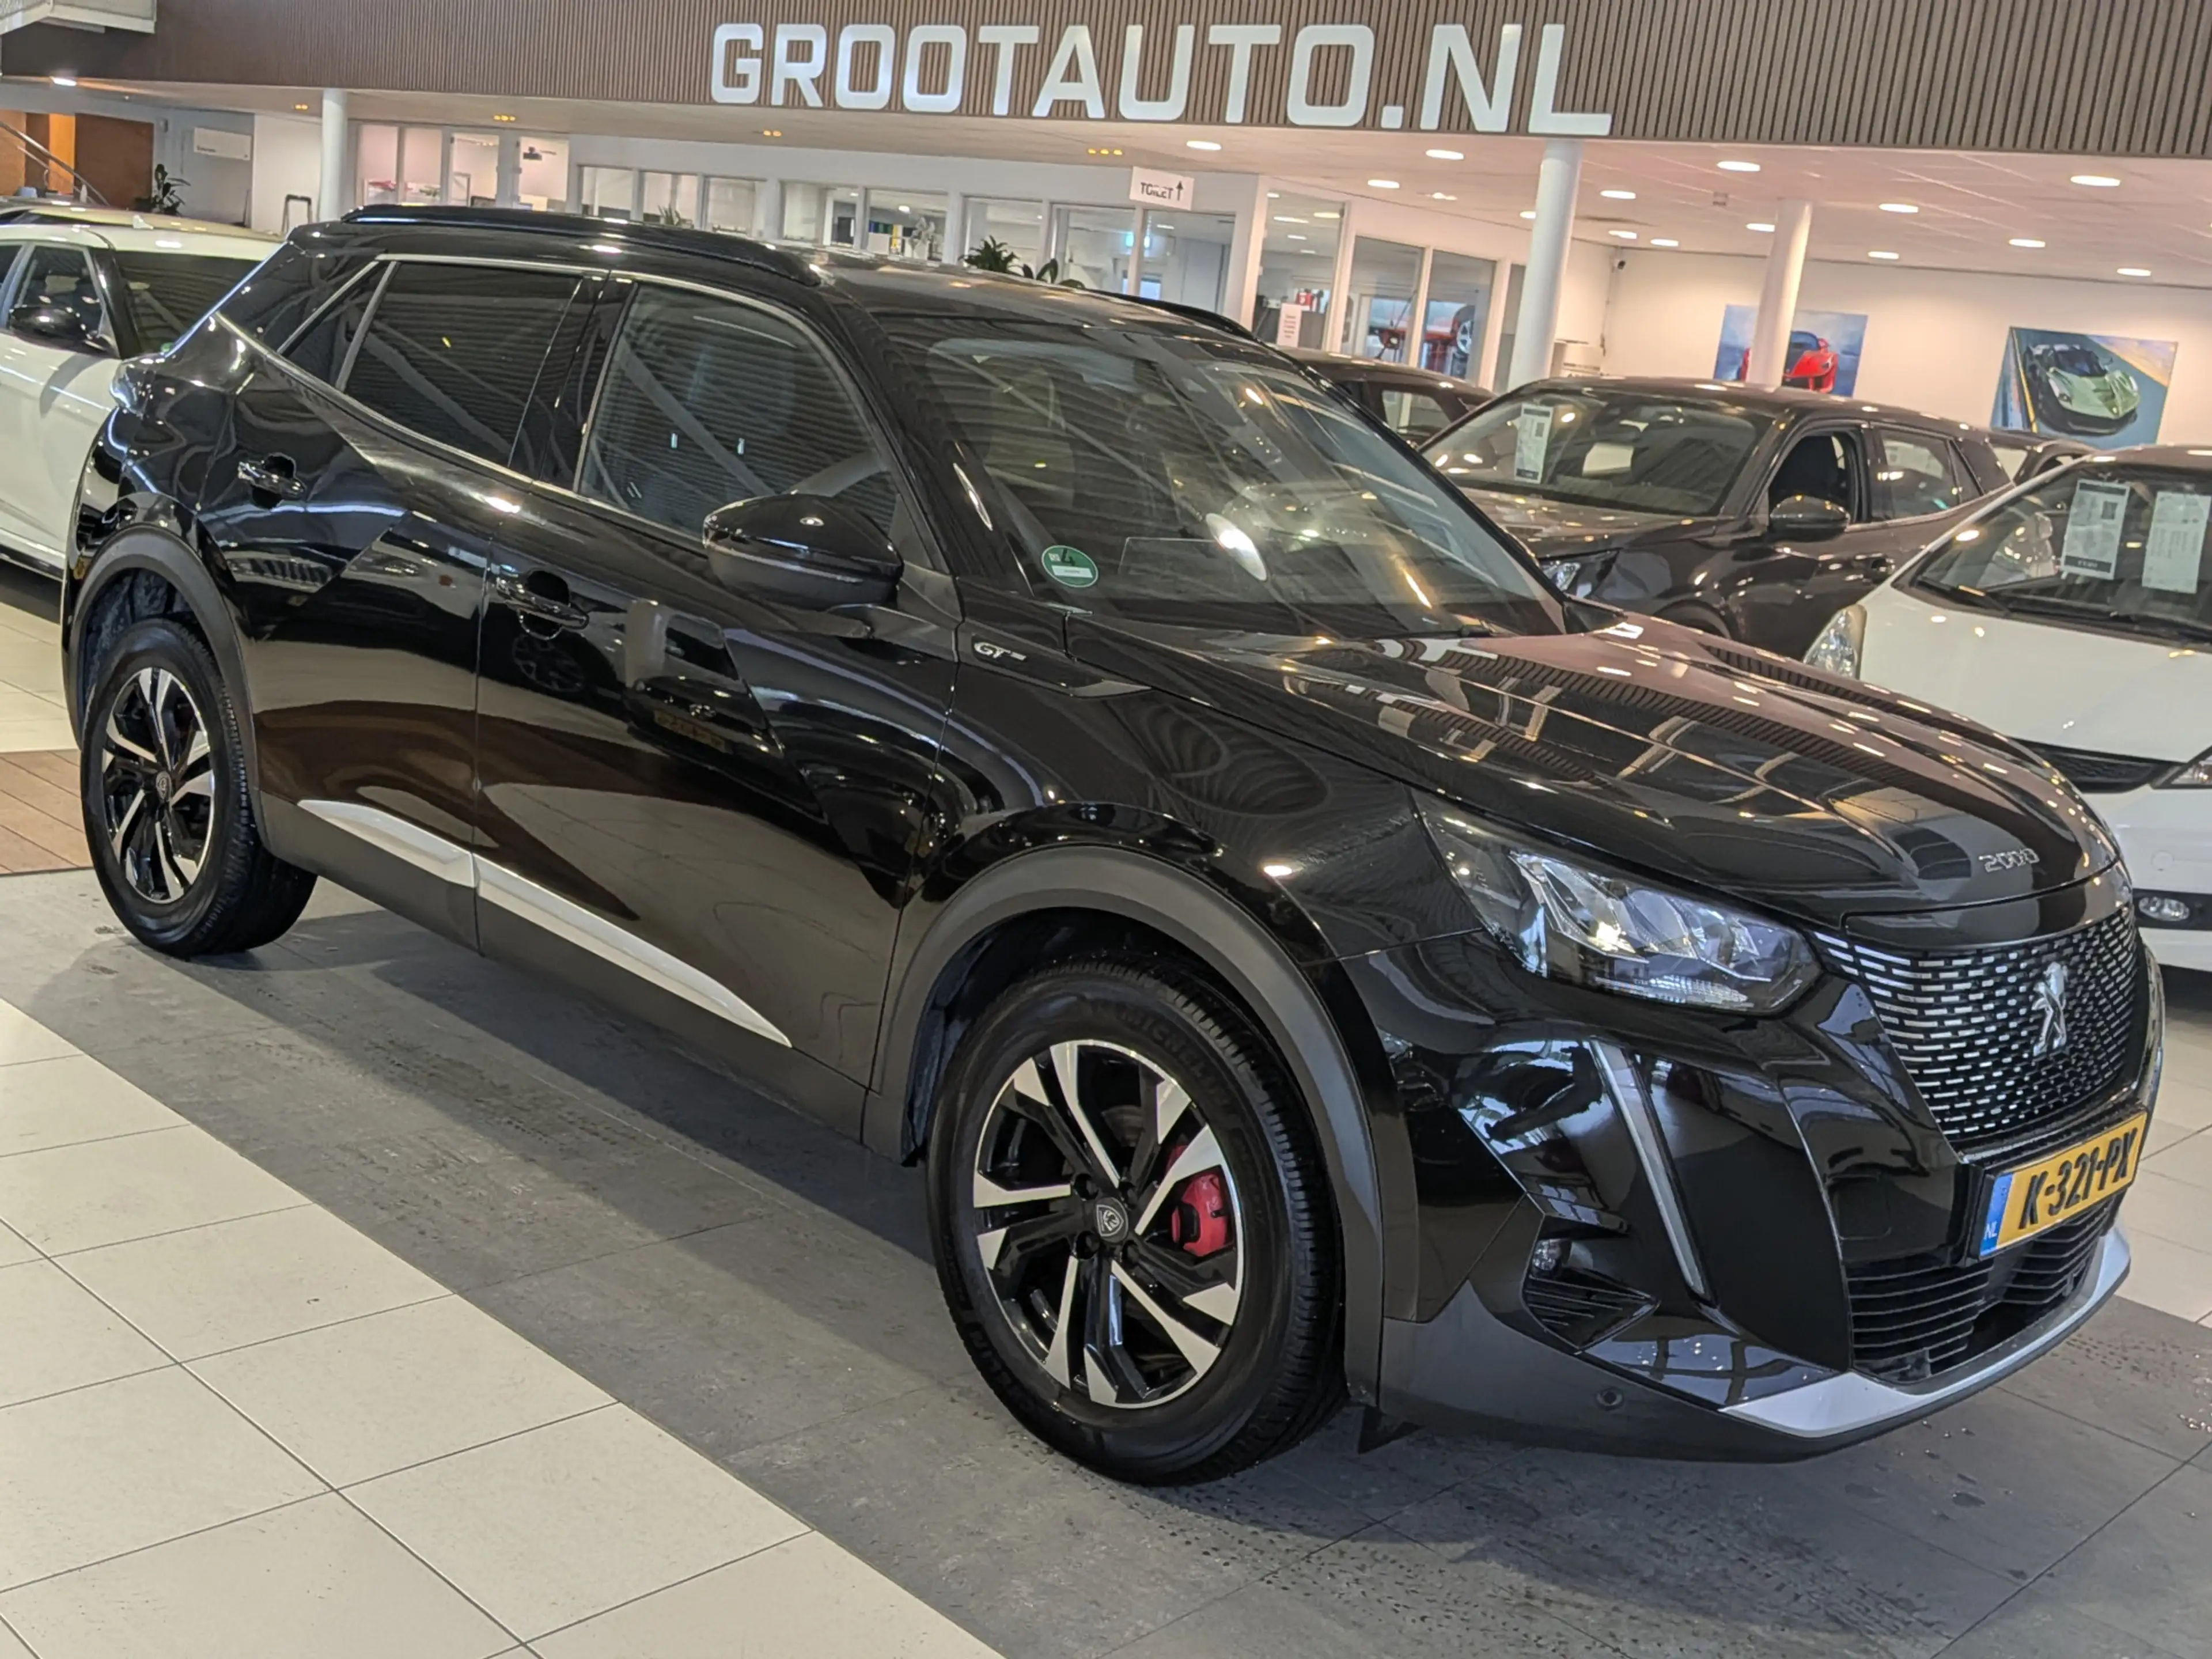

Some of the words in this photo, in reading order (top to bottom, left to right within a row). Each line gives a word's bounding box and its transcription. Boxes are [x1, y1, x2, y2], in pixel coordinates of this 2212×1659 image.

[710, 22, 1612, 136] GROOTAUTO.NL
[1061, 548, 1075, 566] 4
[974, 642, 1014, 659] GT
[2018, 1127, 2137, 1229] K-321-PX
[1983, 1220, 1998, 1241] NL
